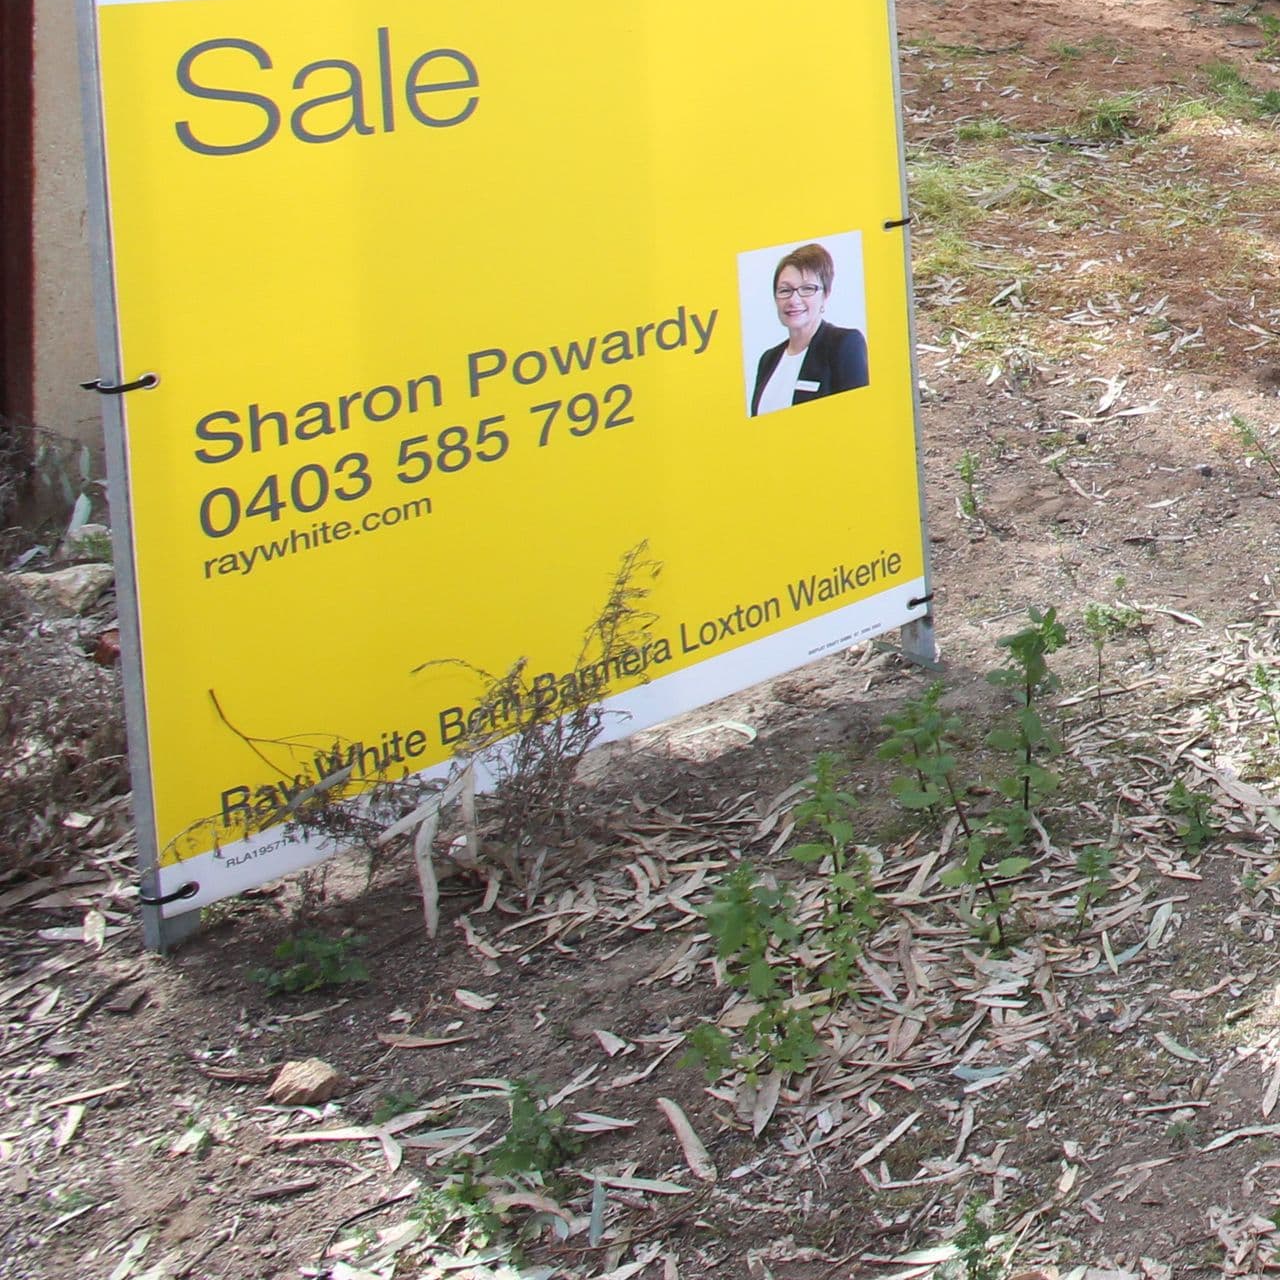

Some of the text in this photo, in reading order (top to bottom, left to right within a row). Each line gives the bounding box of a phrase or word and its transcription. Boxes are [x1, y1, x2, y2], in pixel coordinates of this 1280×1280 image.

[175, 26, 480, 157] Sale
[194, 307, 719, 464] Sharon Powardy
[199, 383, 635, 539] 0403 585 792
[203, 496, 433, 579] raywhite.com
[680, 596, 781, 655] Loxton
[788, 549, 902, 612] Waikerie
